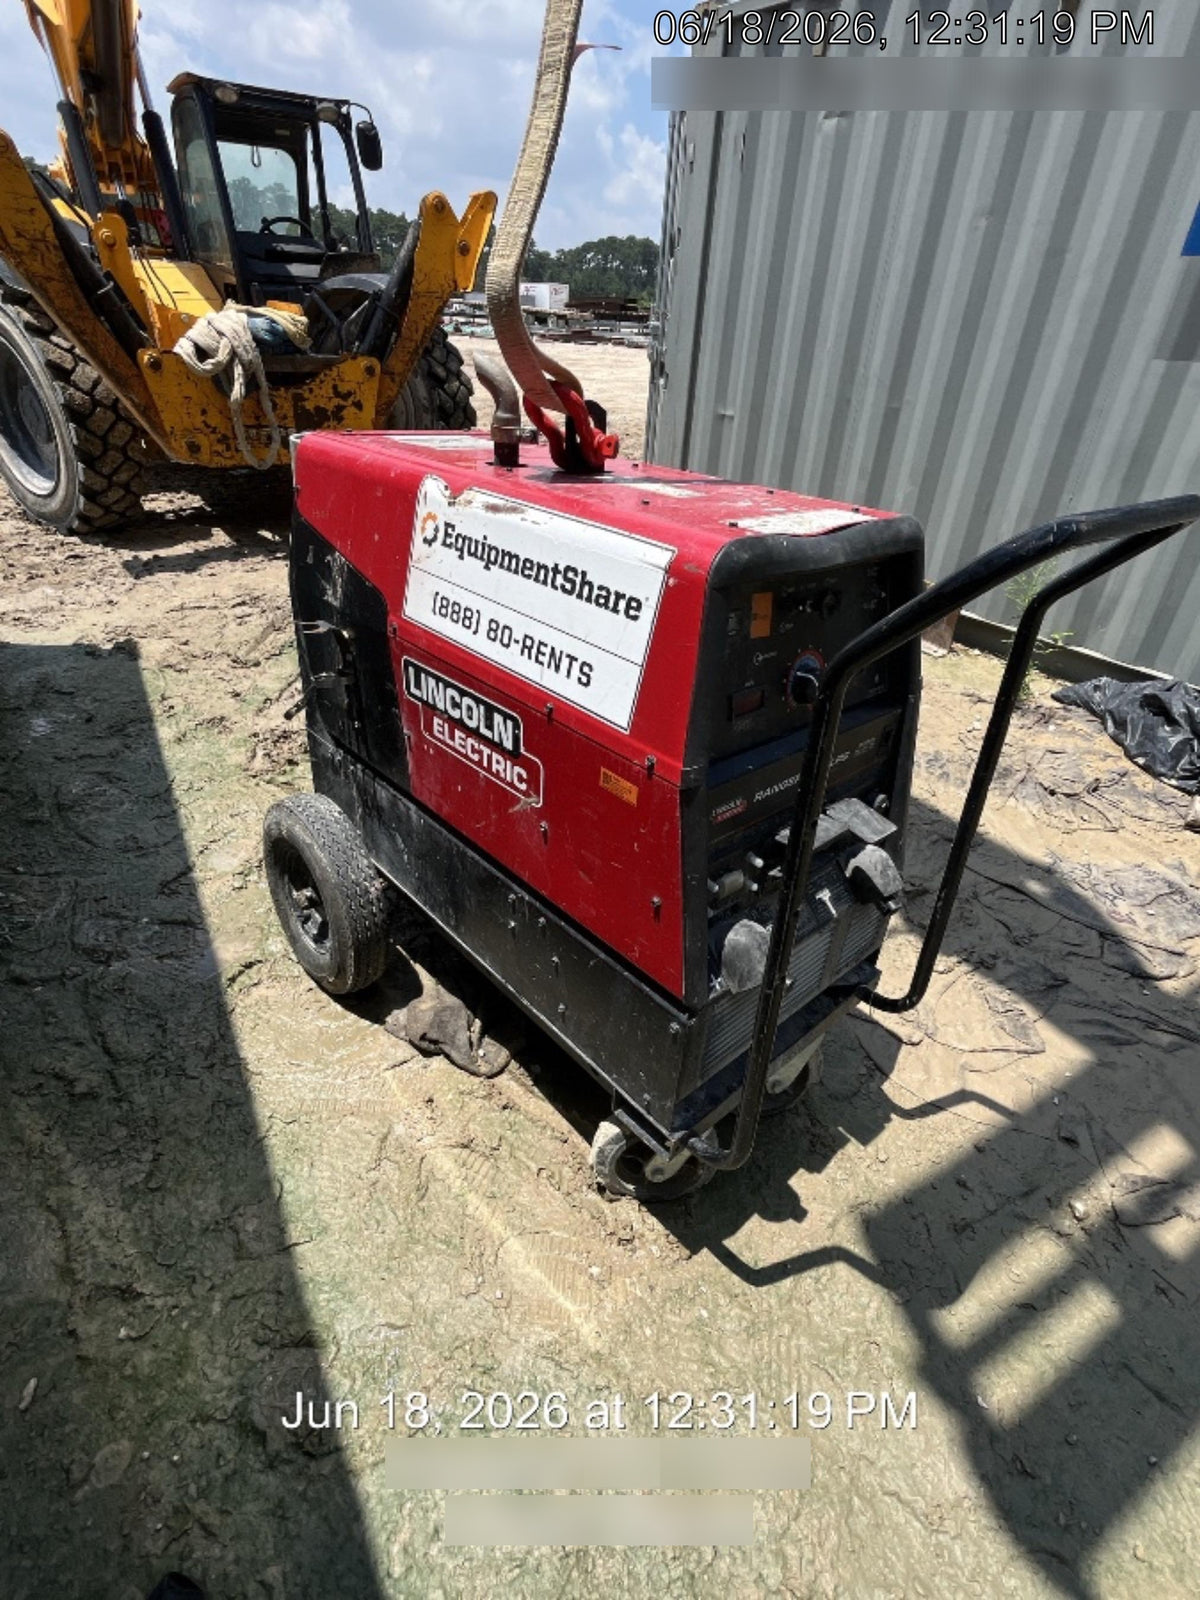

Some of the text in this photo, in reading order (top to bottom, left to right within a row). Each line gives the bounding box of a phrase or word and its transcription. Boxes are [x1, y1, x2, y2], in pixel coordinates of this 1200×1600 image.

[440, 521, 644, 622] EquipmentShare
[431, 590, 594, 689] (888) 80-RENTS
[407, 667, 515, 751] LINCOLN
[432, 716, 528, 791] ELECTRIC
